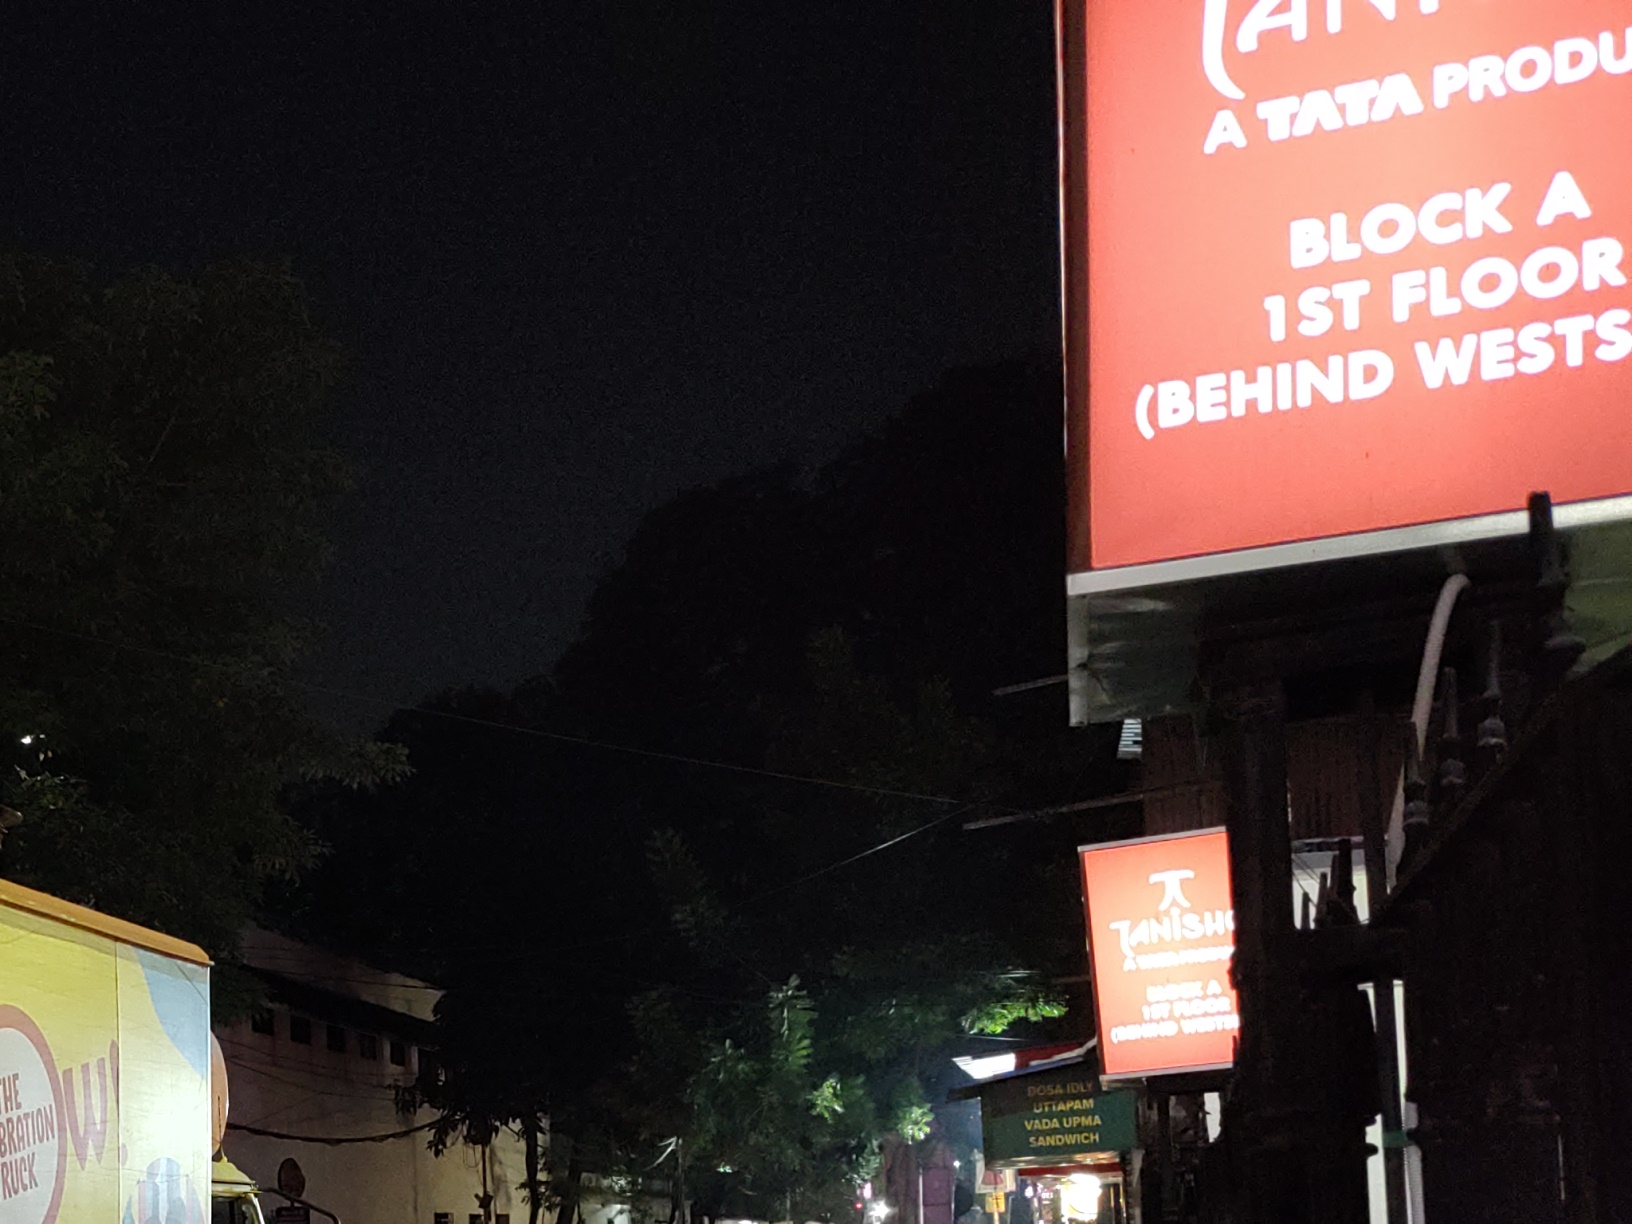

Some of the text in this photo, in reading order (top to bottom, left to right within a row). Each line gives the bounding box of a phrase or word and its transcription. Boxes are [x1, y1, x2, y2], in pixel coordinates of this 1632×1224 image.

[1202, 109, 1247, 154] A
[1256, 73, 1424, 142] TATA
[1288, 171, 1592, 269] BLOCK A
[1263, 237, 1627, 342] 1ST FLOOR
[1134, 309, 1632, 440] (BEHIND WESTS
[1027, 1081, 1094, 1097] DOSA IDLY
[1032, 1098, 1095, 1114] UTTAPAM
[1024, 1115, 1103, 1131] VADA UPMA
[1028, 1132, 1100, 1148] SANDWICH
